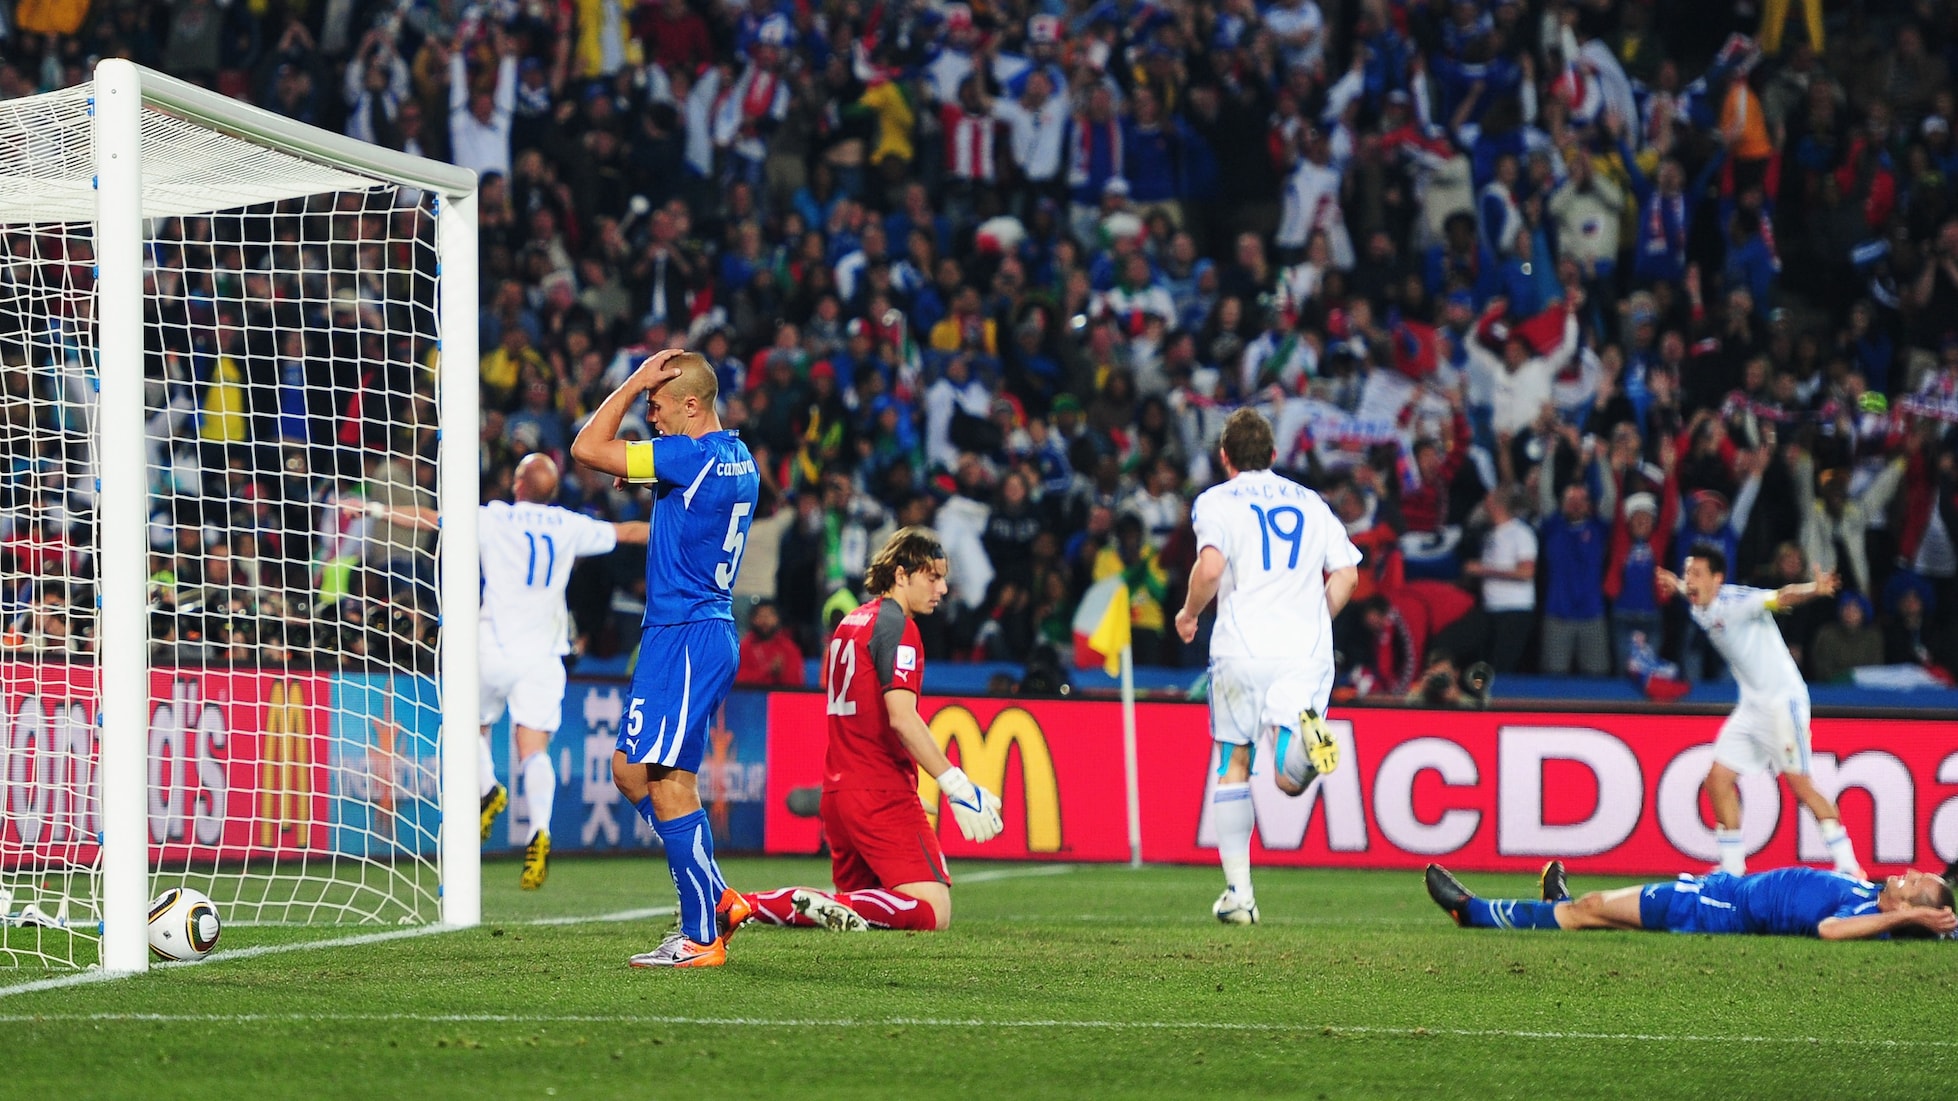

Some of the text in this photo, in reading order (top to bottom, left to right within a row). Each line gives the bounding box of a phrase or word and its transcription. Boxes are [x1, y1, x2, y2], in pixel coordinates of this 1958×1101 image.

[524, 531, 555, 587] 11
[714, 502, 752, 591] 5
[1250, 503, 1305, 571] 19
[826, 638, 857, 716] 12
[627, 698, 645, 736] 5
